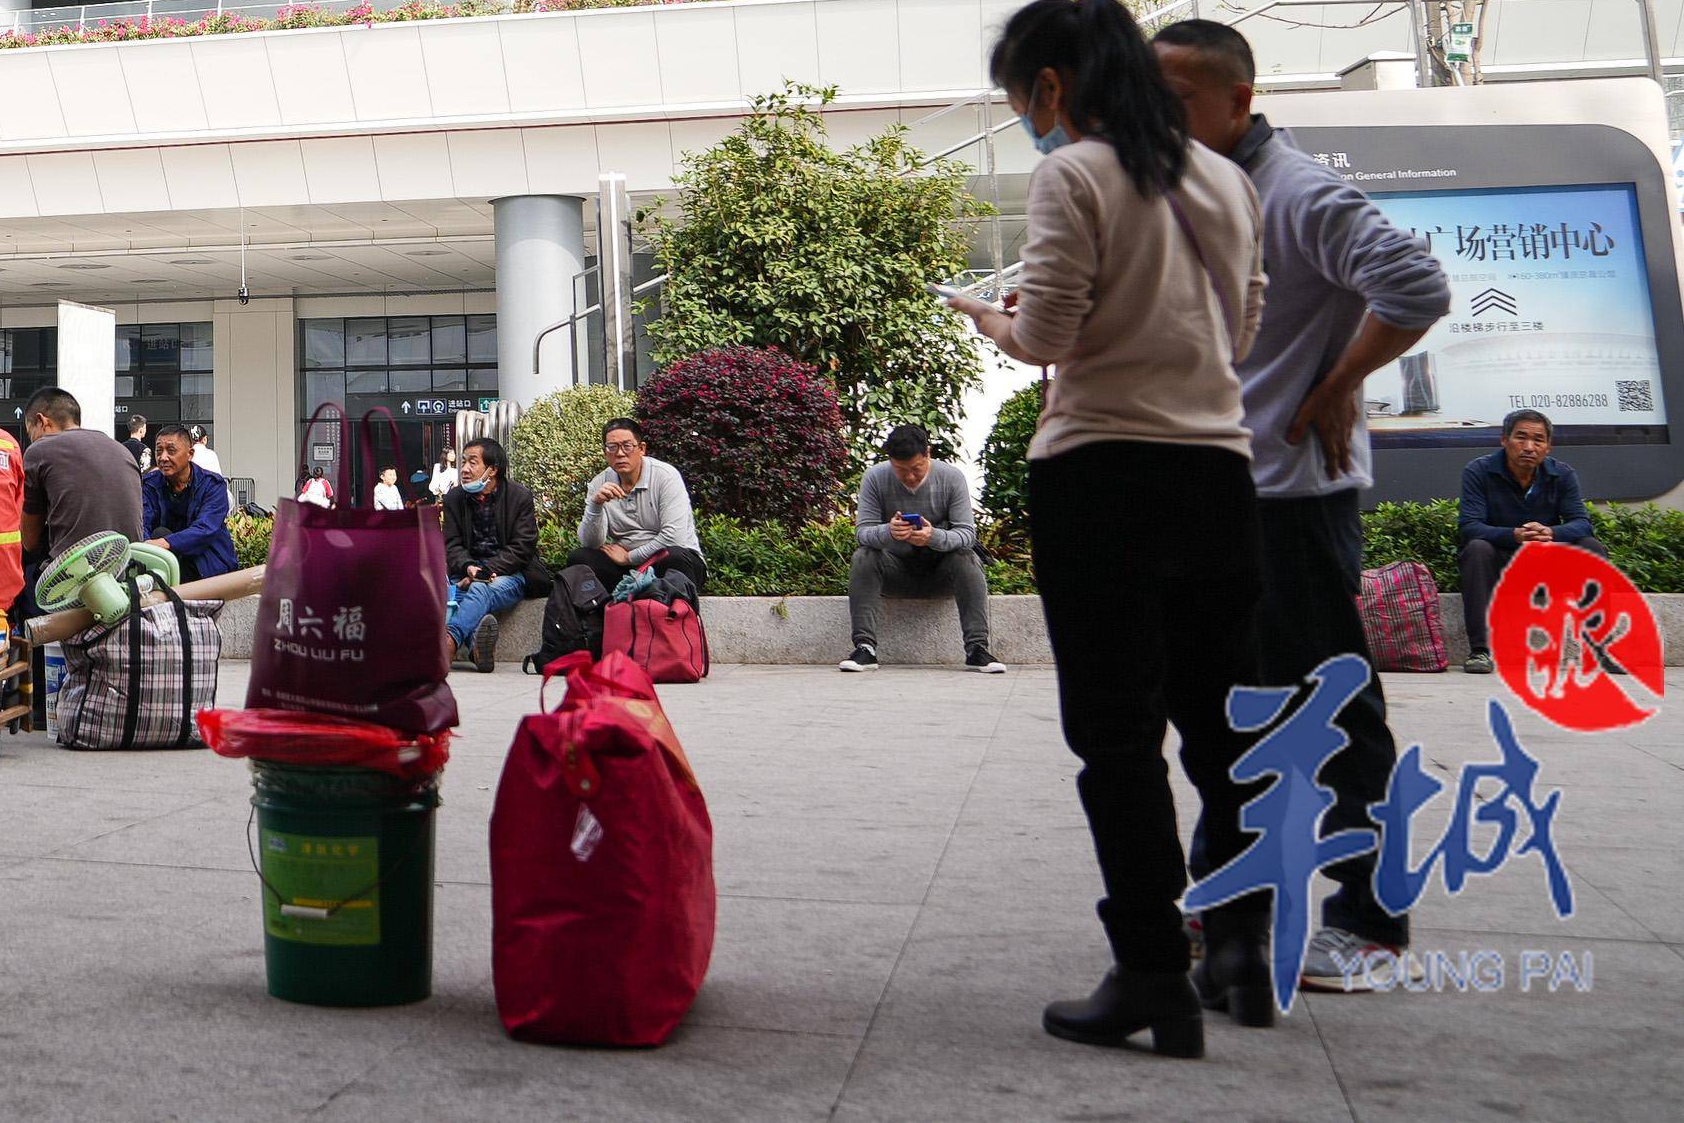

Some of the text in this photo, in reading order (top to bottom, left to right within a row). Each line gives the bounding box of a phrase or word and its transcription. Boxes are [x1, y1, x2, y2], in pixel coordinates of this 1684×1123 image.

[1355, 170, 1396, 181] General
[1398, 168, 1456, 179] Information
[1411, 222, 1614, 261] 广场营销中心
[276, 598, 366, 641] 周六福
[274, 638, 364, 661] ZHOU LIU FU
